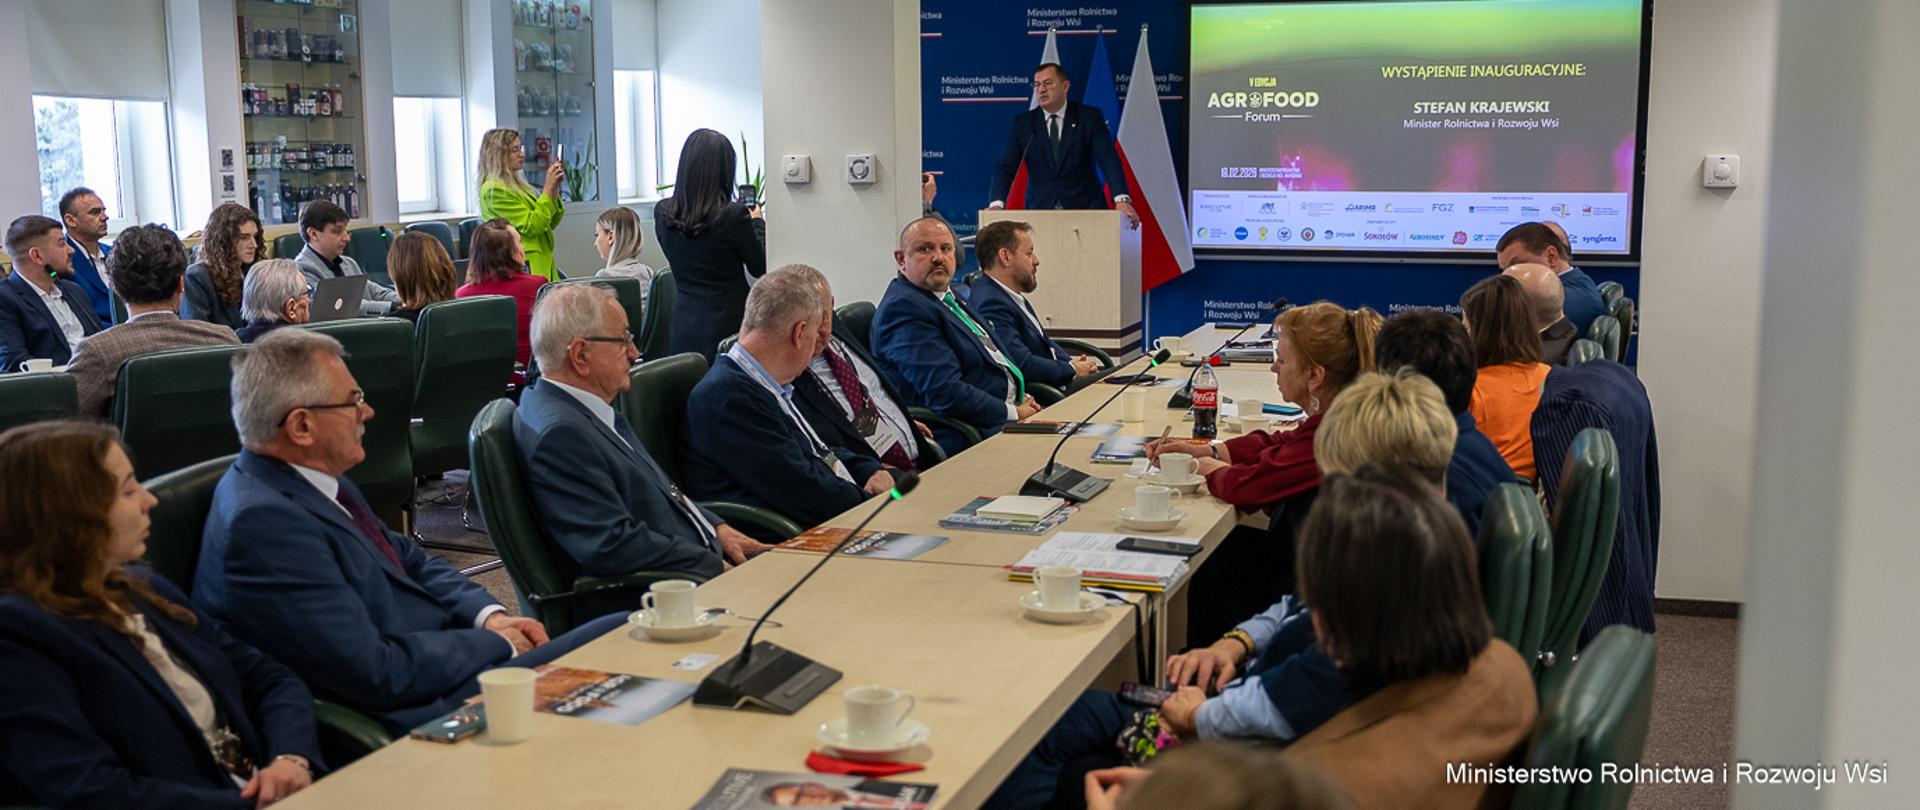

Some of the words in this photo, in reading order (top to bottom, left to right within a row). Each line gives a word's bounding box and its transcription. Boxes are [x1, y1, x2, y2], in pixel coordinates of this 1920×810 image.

[1027, 8, 1077, 17] Ministerstwo
[1079, 7, 1118, 16] Rolnictwa
[1031, 18, 1064, 28] Rozwoju
[1065, 17, 1082, 26] Wsi
[1381, 65, 1468, 80] WYSTĄPIENIE
[1470, 63, 1587, 77] INAUGURACYJNE:
[941, 76, 991, 85] Ministerstwo
[991, 75, 1029, 84] Rolnictwa
[945, 86, 978, 95] Rozwoju
[979, 85, 995, 94] Wsi
[1413, 101, 1466, 114] STEFAN
[1469, 101, 1550, 113] KRAJEWSKI
[1245, 111, 1281, 122] Forum
[1403, 119, 1442, 129] Minister
[1444, 118, 1490, 129] Rolnictwa
[1498, 118, 1539, 131] Rozwoju
[1540, 118, 1560, 128] Wsi
[1582, 233, 1618, 245] syngenta
[1204, 300, 1256, 310] Ministerstwo
[1208, 309, 1243, 320] Rozwoju
[1243, 310, 1260, 319] Wsi
